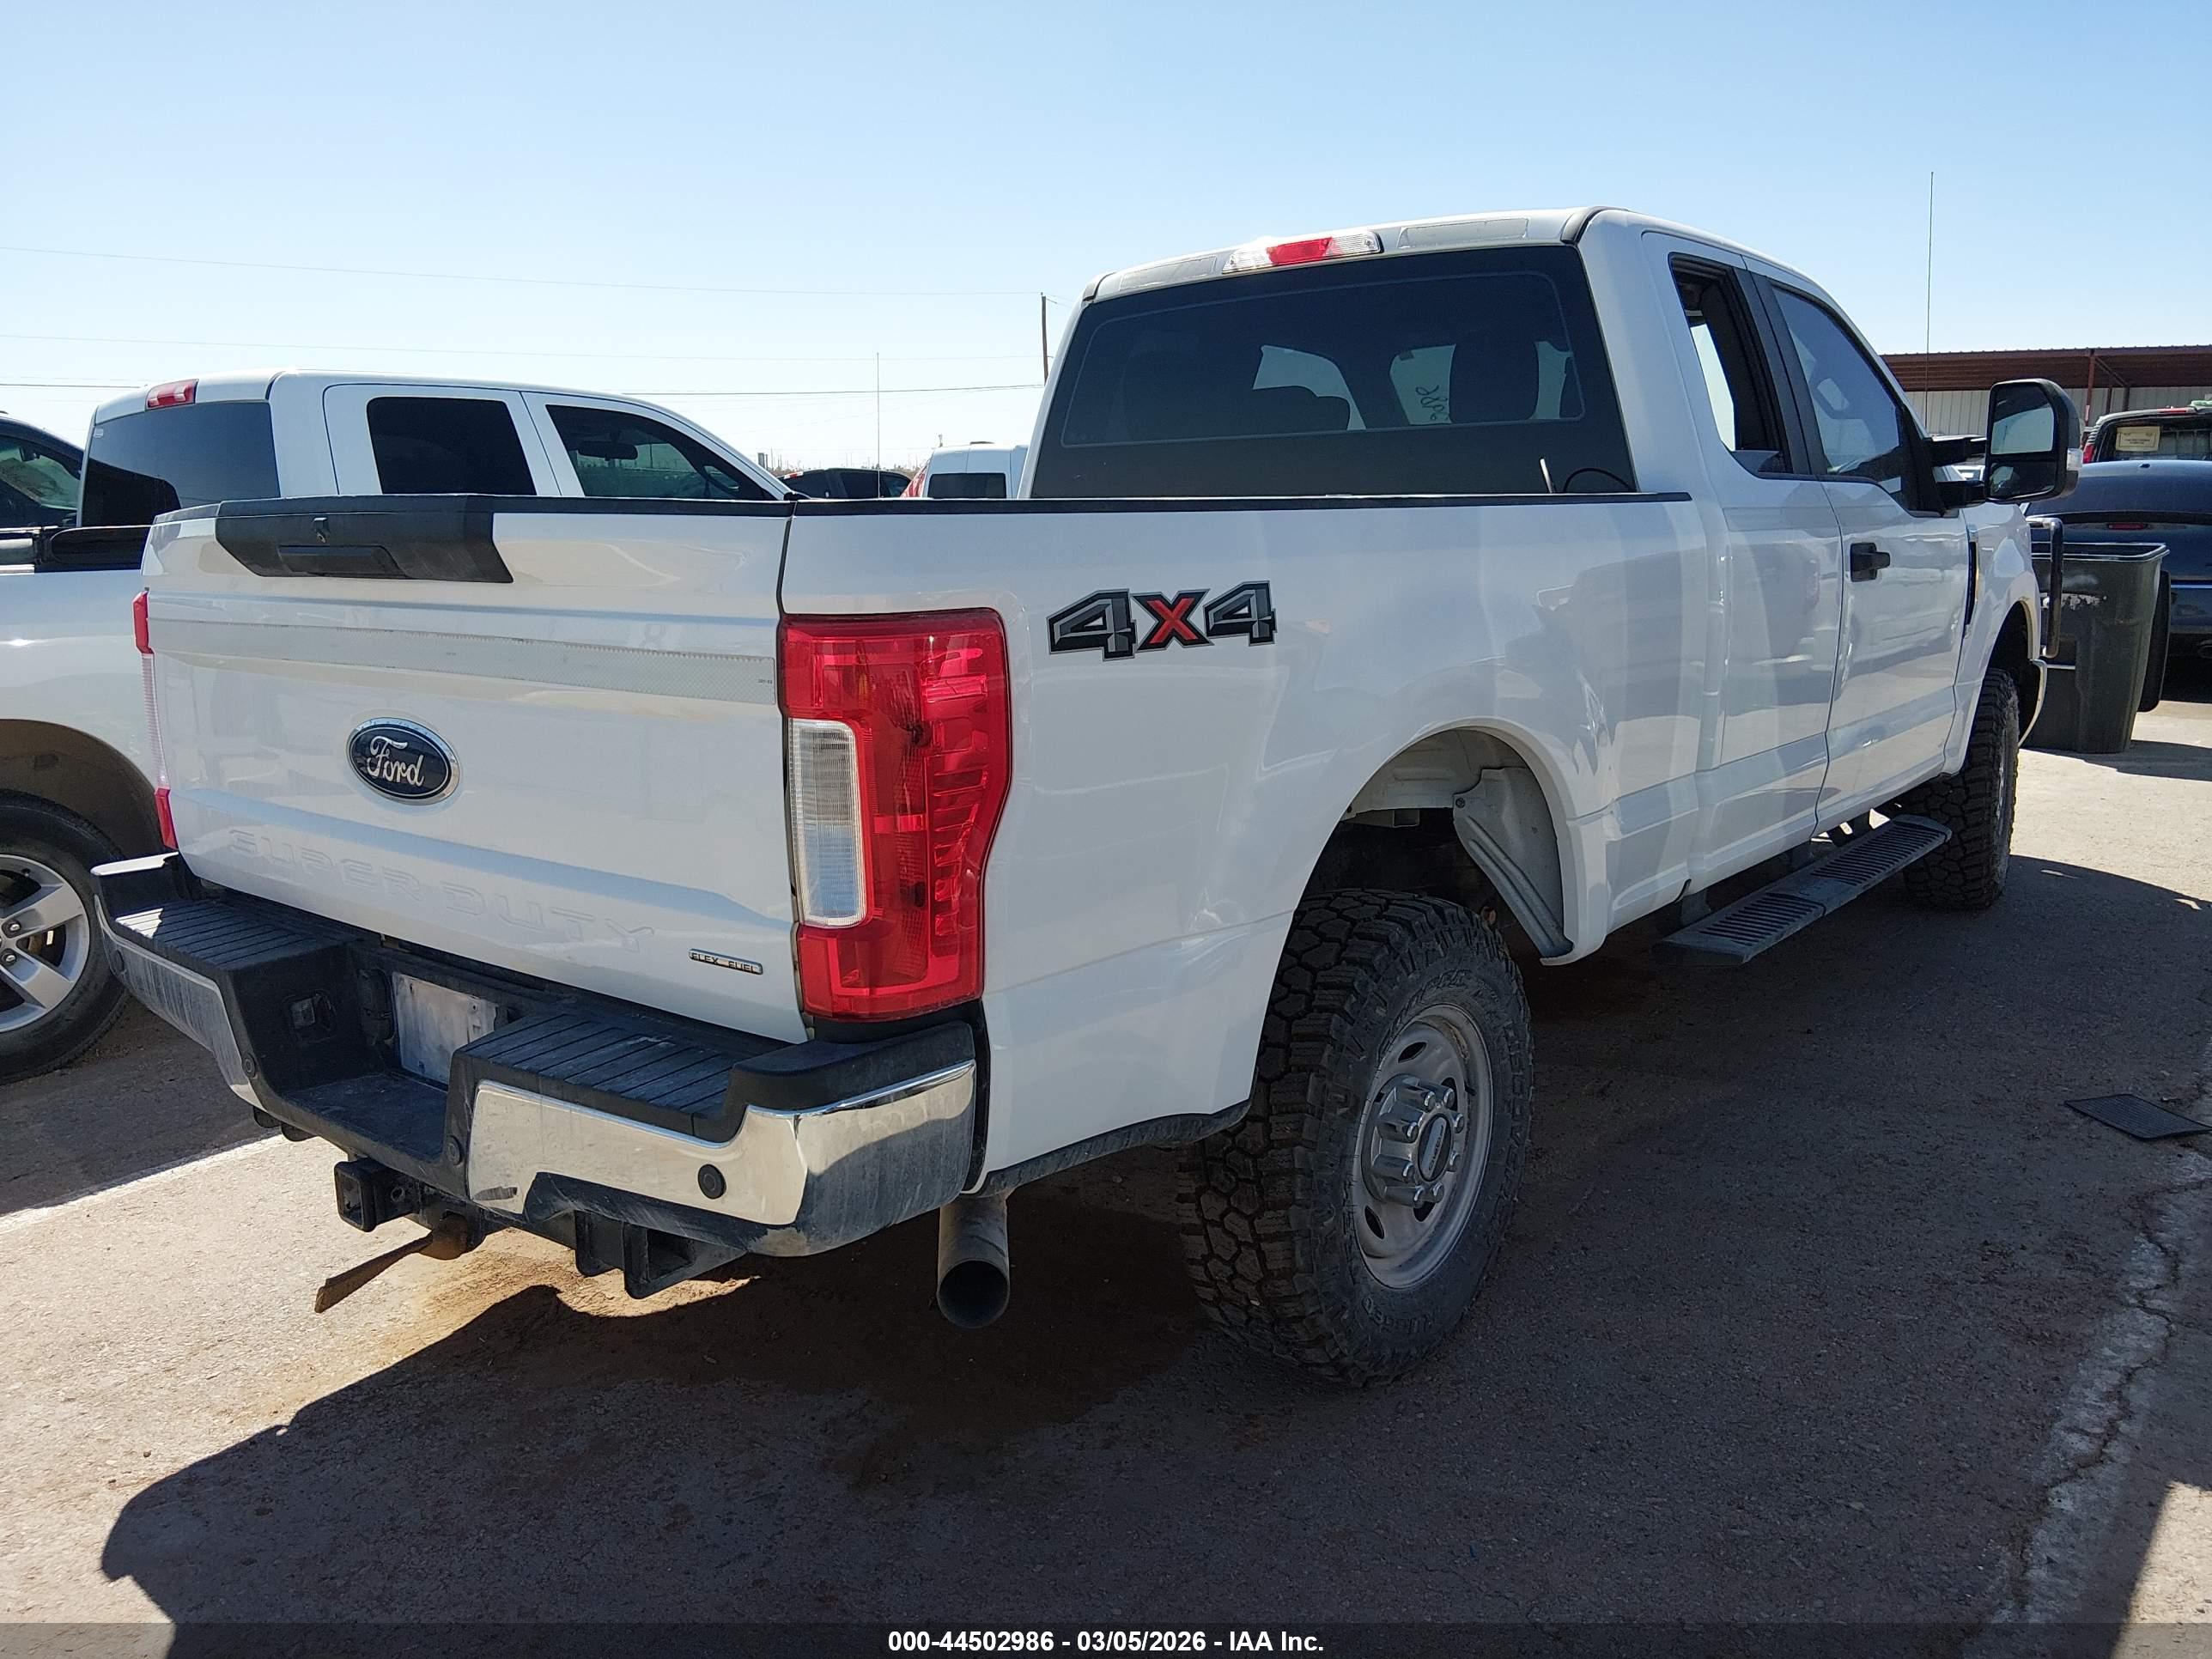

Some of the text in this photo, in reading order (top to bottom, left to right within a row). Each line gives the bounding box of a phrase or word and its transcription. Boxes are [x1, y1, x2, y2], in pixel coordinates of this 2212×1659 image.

[367, 736, 425, 787] Ford
[228, 828, 656, 954] SUPER DUTY
[690, 951, 760, 975] FLEX FUEL
